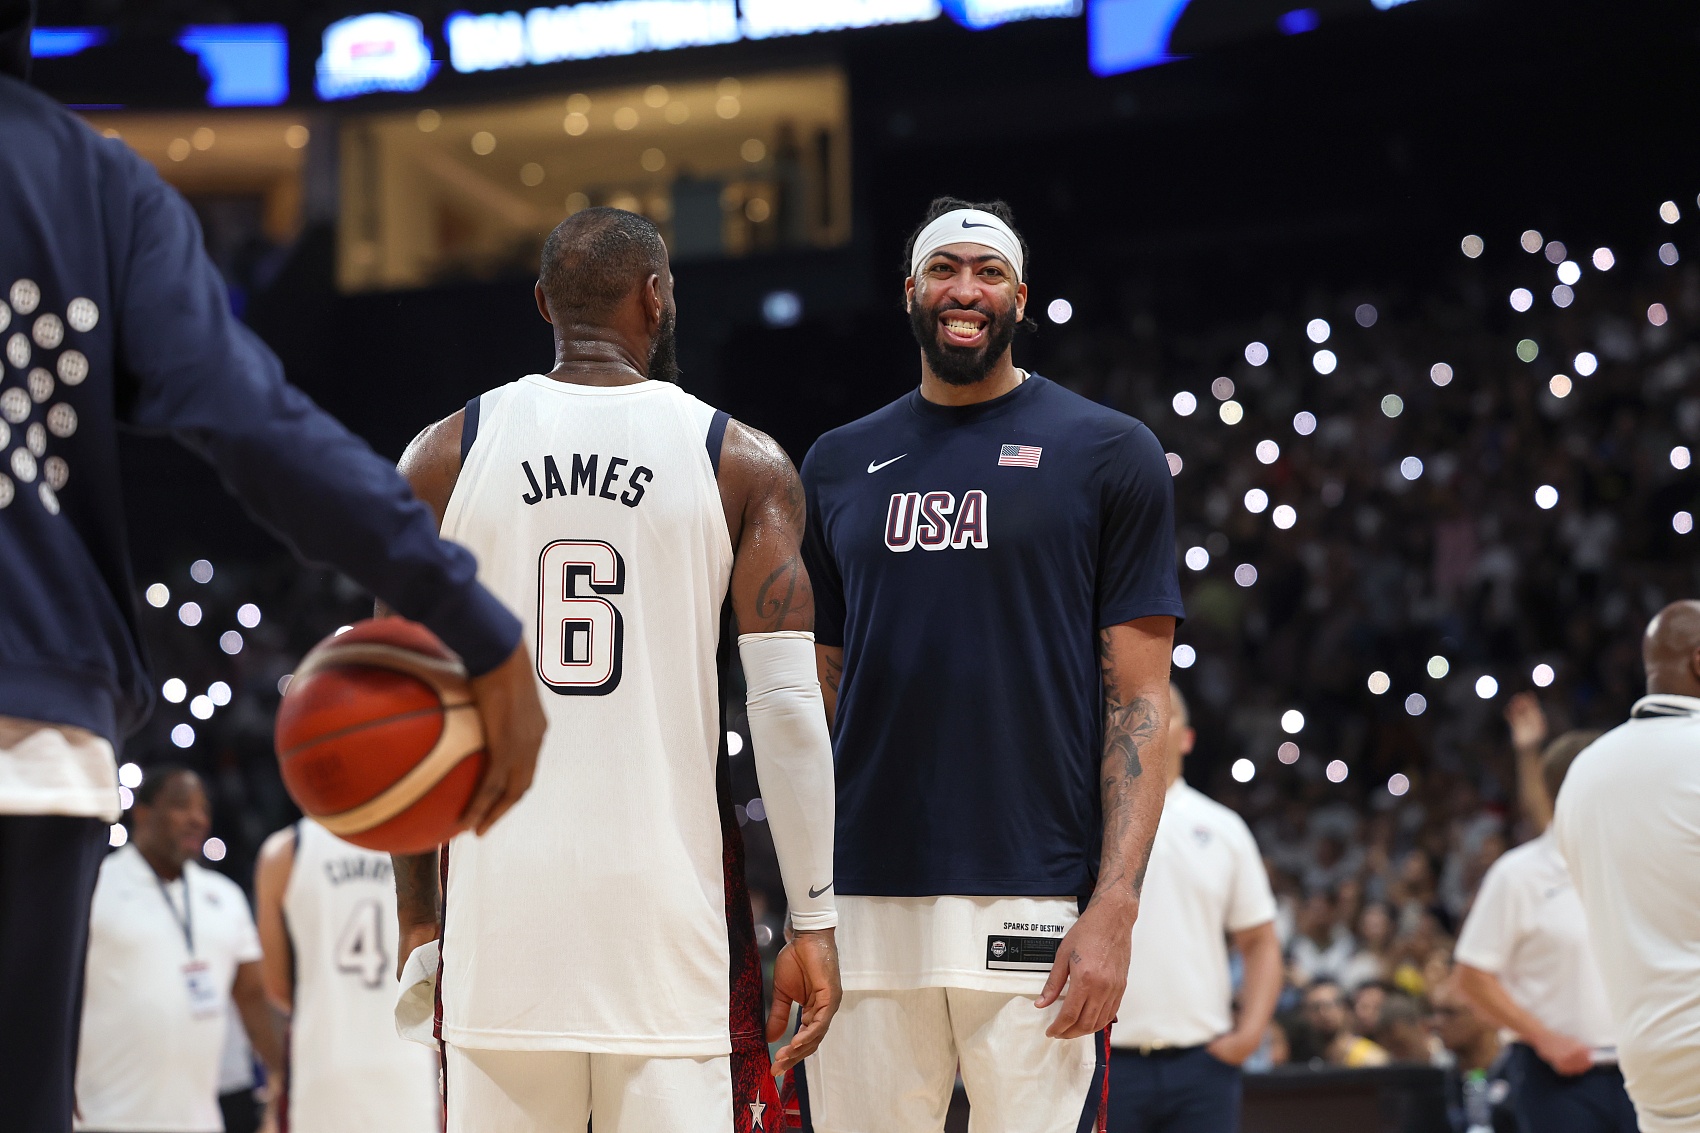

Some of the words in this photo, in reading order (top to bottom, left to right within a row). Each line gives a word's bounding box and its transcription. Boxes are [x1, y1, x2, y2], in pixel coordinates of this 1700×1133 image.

[521, 453, 654, 508] JAMES
[884, 489, 989, 553] USA
[536, 538, 626, 696] 6
[333, 897, 390, 989] 4
[1003, 921, 1030, 931] SPARKS
[1030, 923, 1039, 931] OF
[1039, 924, 1065, 933] DESTINY
[1010, 946, 1019, 954] 54
